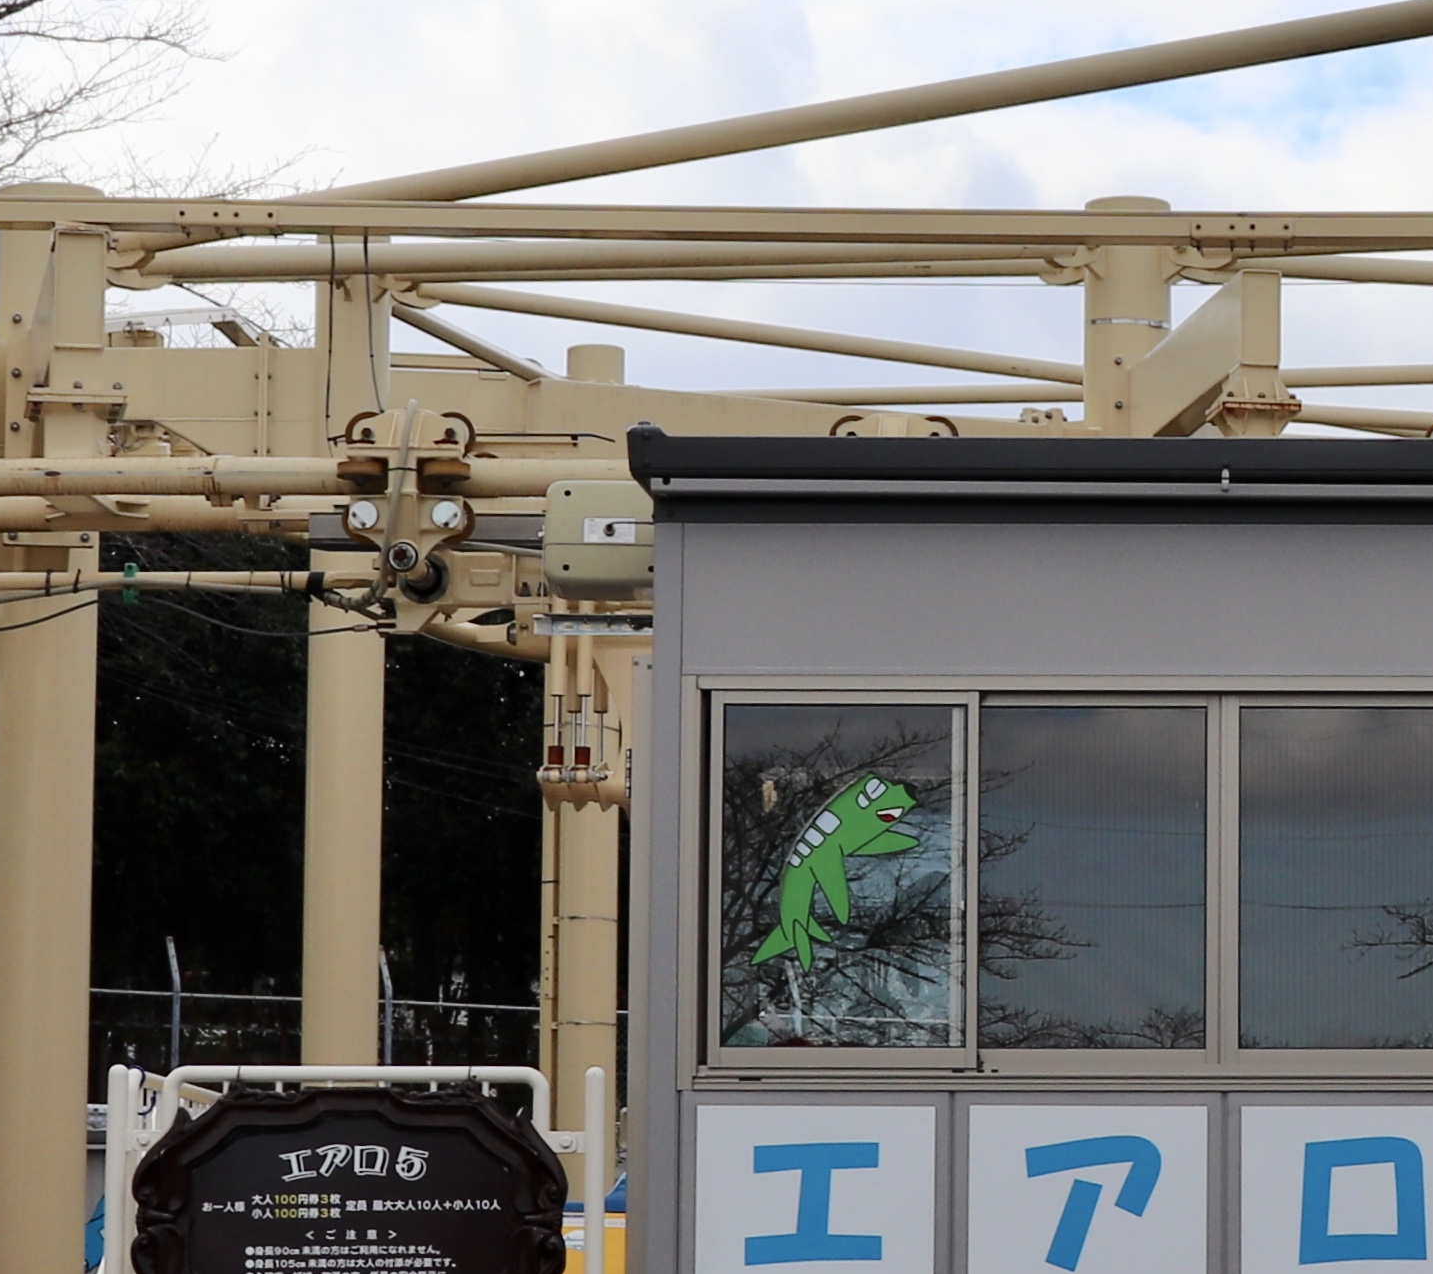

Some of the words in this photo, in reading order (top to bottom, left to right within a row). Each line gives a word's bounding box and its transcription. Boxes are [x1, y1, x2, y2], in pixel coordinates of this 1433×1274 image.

[279, 1144, 428, 1181] エアロ5
[202, 1201, 246, 1213] お一人様
[345, 1200, 368, 1212] 定員
